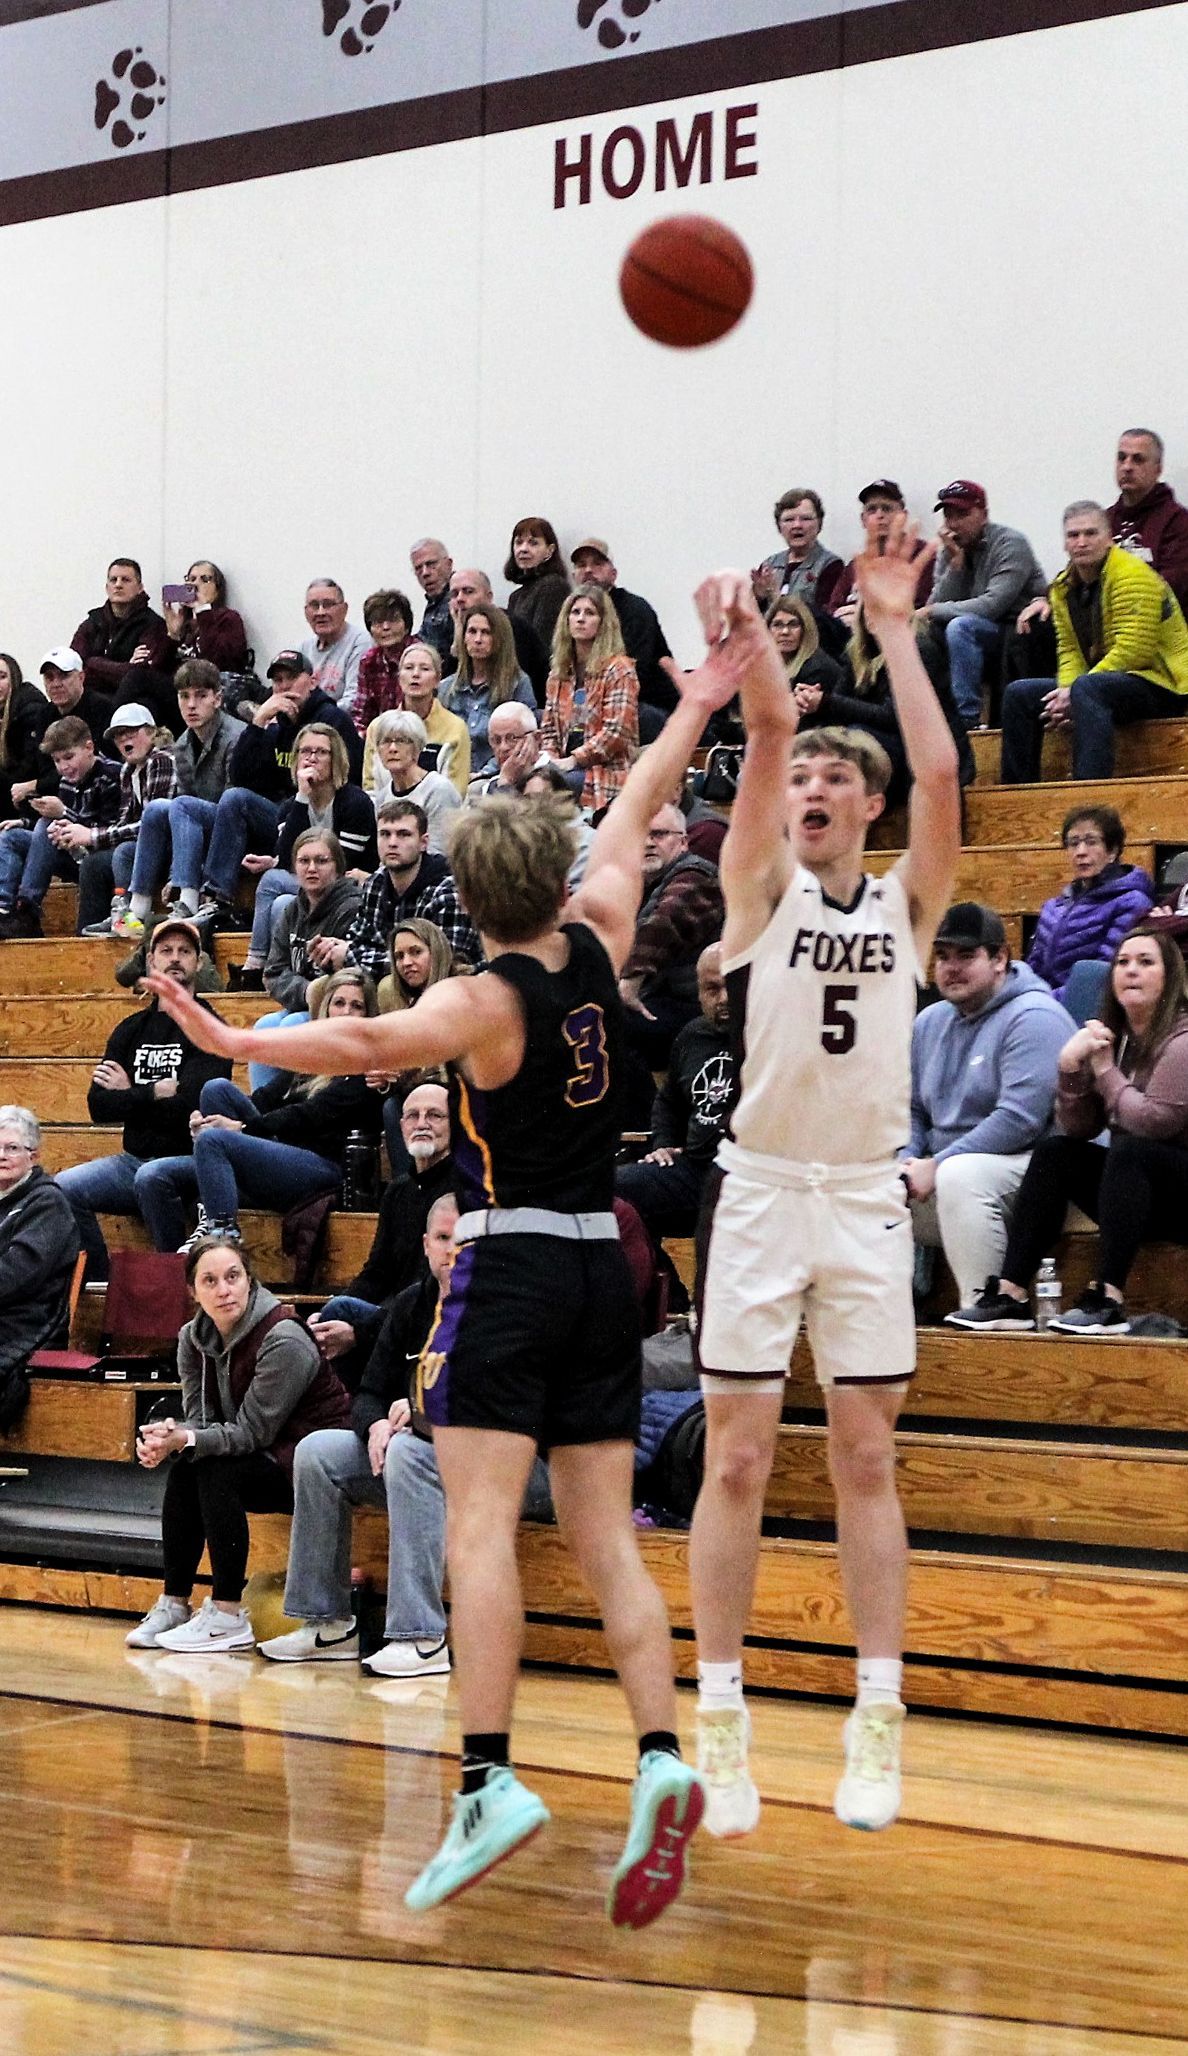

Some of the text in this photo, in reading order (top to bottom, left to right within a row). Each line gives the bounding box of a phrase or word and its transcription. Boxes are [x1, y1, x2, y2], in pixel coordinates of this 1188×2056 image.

[554, 102, 758, 209] HOME
[788, 928, 896, 973] FOXES
[821, 985, 858, 1054] 5
[133, 1048, 183, 1068] FOXES
[561, 1002, 609, 1107] 3
